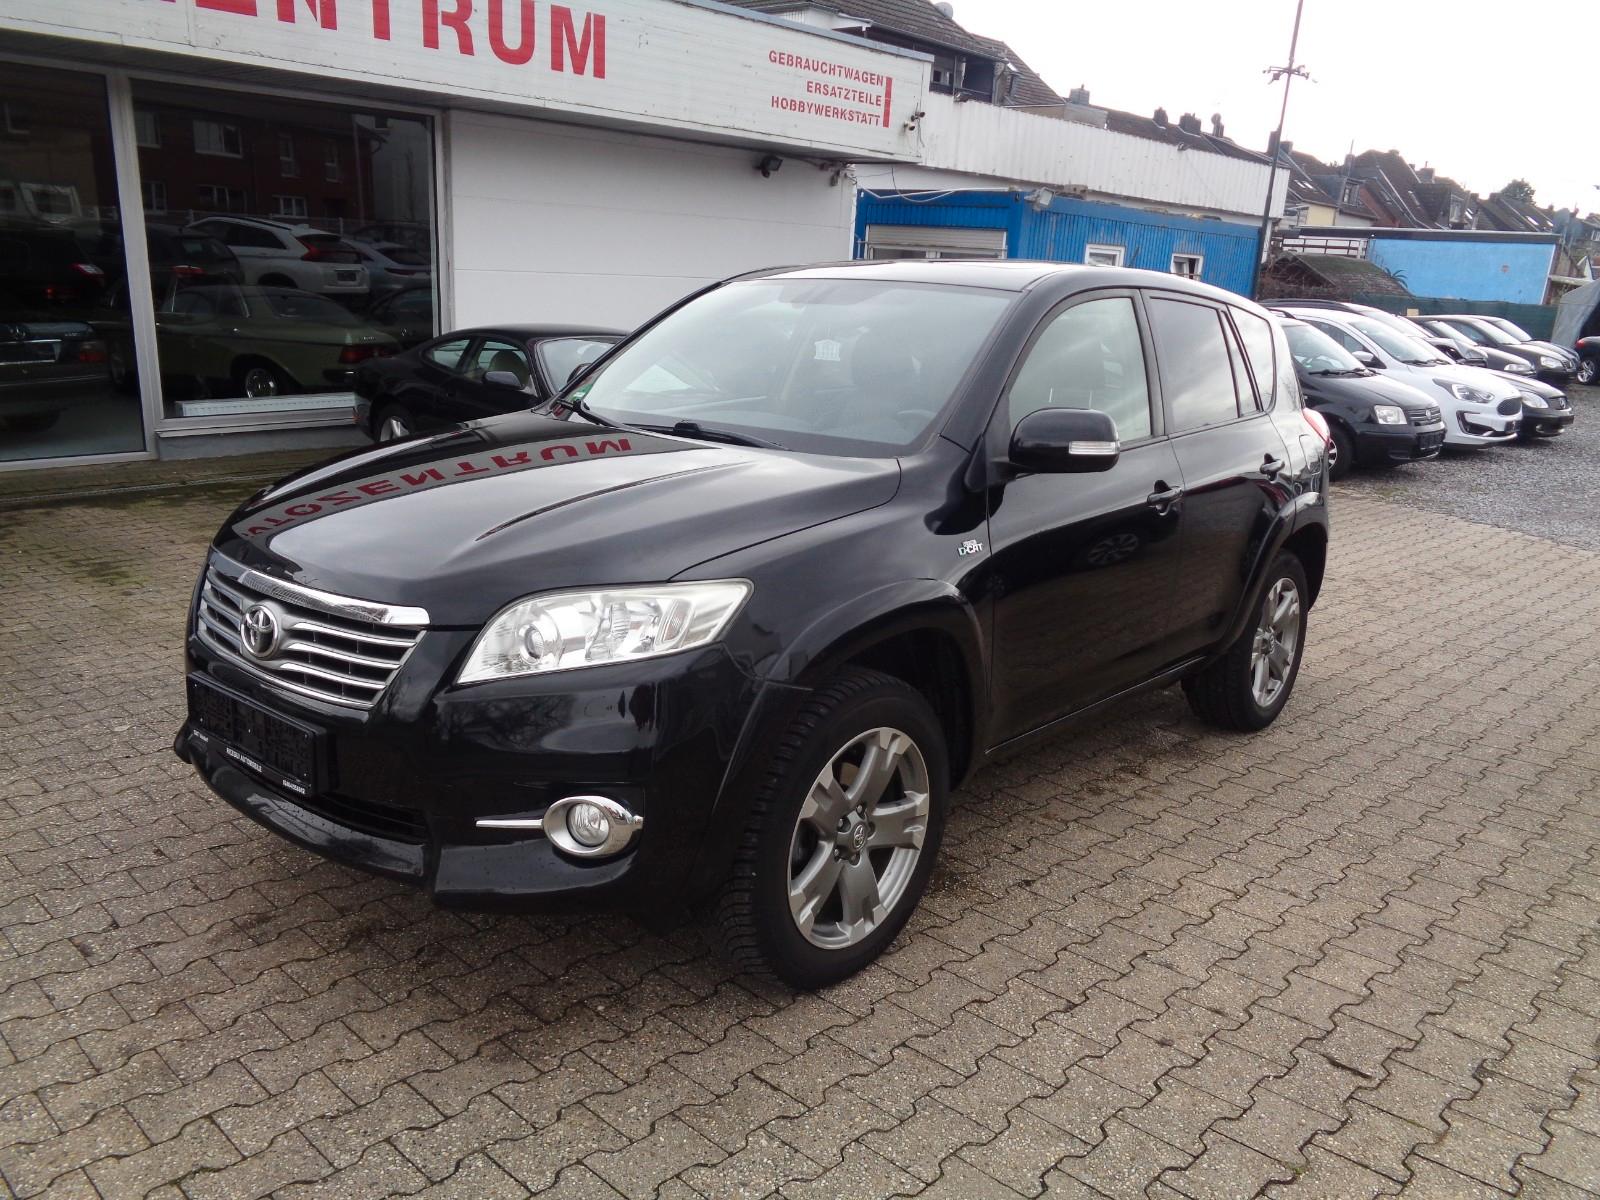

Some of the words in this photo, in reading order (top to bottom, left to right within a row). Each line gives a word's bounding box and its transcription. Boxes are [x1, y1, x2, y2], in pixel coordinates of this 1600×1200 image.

[768, 50, 884, 87] GEBRAUCHTWAGEN
[806, 80, 882, 107] ERSATZTEILE
[771, 95, 881, 126] HOBBYWERKSTATT
